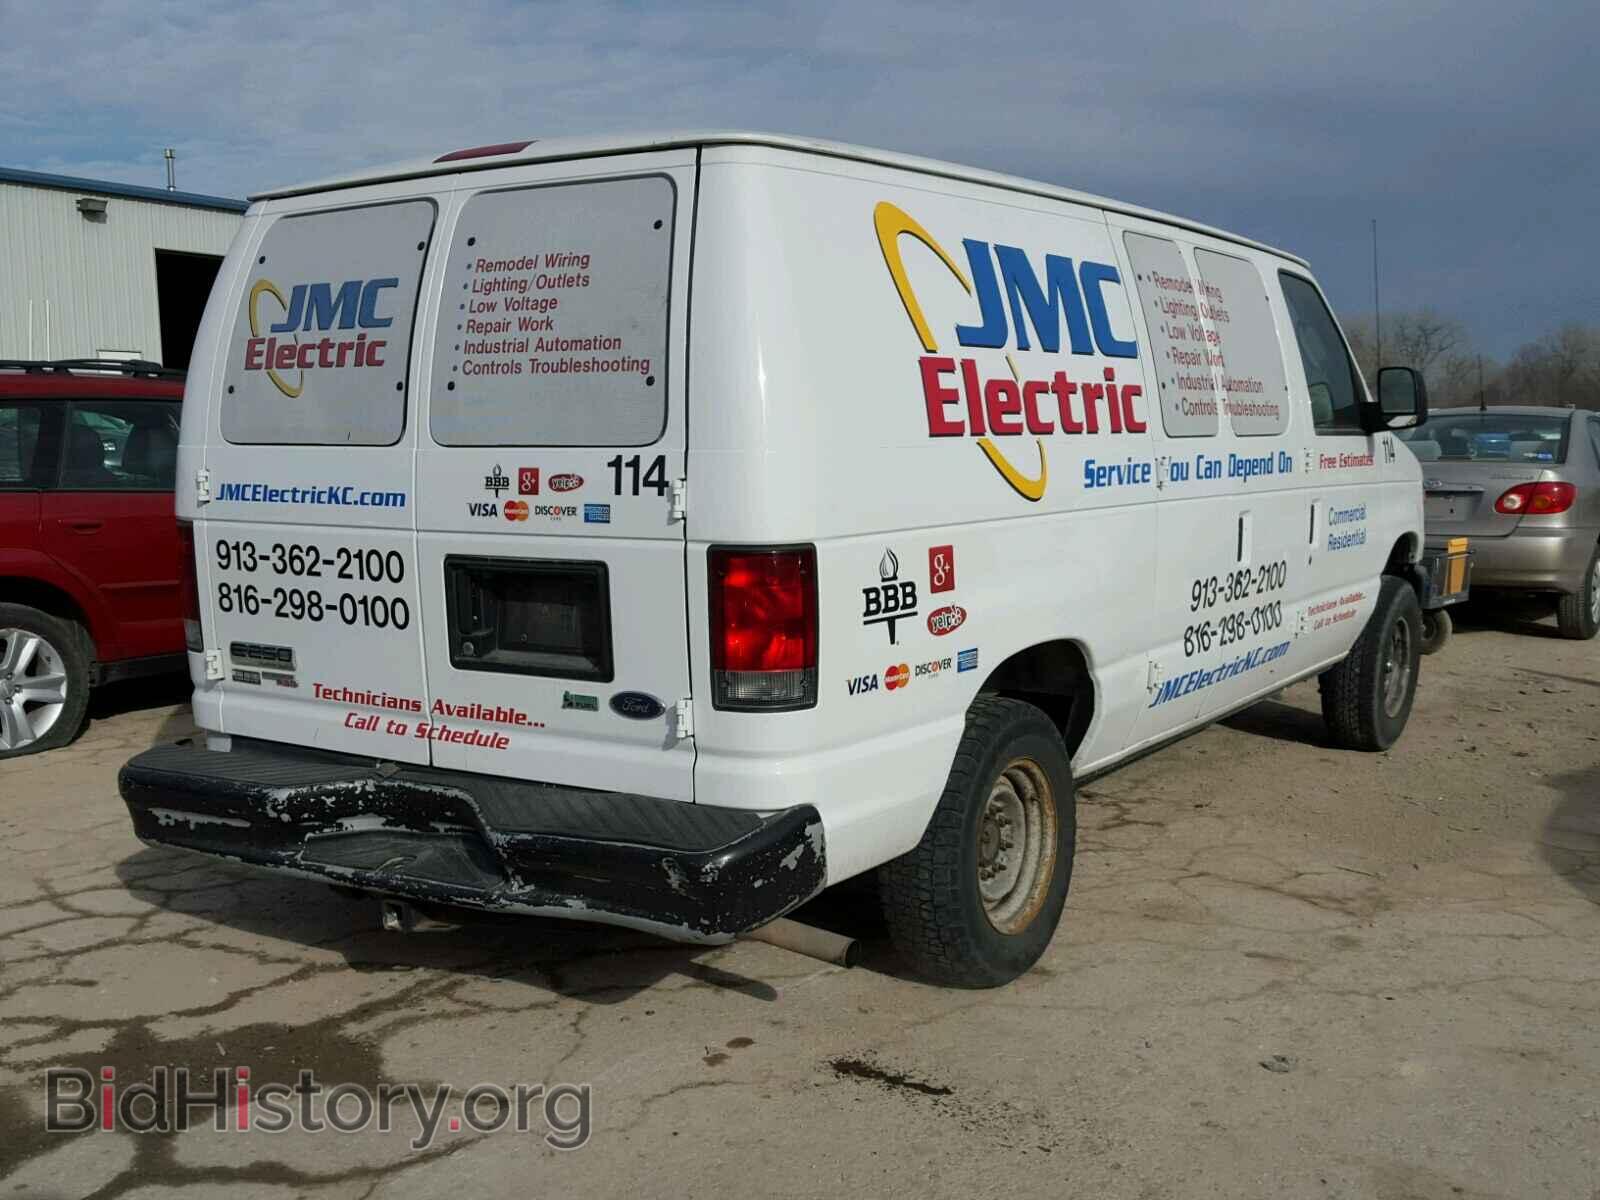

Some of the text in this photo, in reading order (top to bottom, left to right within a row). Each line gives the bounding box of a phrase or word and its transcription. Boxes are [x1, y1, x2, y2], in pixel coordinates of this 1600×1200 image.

[475, 252, 590, 273] Remodel Wiring
[472, 273, 590, 296] Lighting/Outlets
[271, 277, 399, 333] JMC
[469, 296, 558, 314] Low Voltage
[955, 238, 1138, 358] JMC
[466, 315, 554, 335] Repair Work
[1166, 322, 1186, 339] Low
[244, 333, 387, 370] Electric
[464, 335, 622, 354] Industrial Automation
[462, 356, 651, 375] Controls Troubleshooting
[1172, 347, 1201, 368] Repair
[919, 356, 1147, 437] Electric
[1181, 396, 1217, 416] Controls
[1320, 452, 1374, 469] Free Estimates
[1382, 438, 1396, 464] 114
[607, 454, 669, 496] 114
[1084, 457, 1151, 488] Service
[1196, 455, 1221, 479] Can
[1228, 452, 1273, 482] Depend
[1278, 451, 1292, 473] On
[485, 475, 510, 489] BBB
[216, 484, 406, 507] JMCElectricKC.com
[467, 502, 498, 517] VISA
[535, 504, 577, 517] DISCOVER
[1328, 504, 1366, 526] Commercial
[1328, 528, 1366, 551] Residential
[216, 540, 405, 584] 913-362-2100
[1190, 560, 1287, 612] 913-362-2100
[218, 582, 410, 630] 816-298-0100
[862, 581, 918, 617] BBB
[931, 612, 952, 632] yelp
[1184, 600, 1282, 657] 816-298-0100
[915, 657, 952, 677] DISCOVER
[1148, 641, 1291, 708] JMCElectricKC.com
[846, 674, 879, 696] VISA
[312, 683, 421, 713] Technicians
[431, 699, 545, 728] Available...
[622, 696, 650, 713] Ford
[344, 712, 510, 750] Call to Schedule
